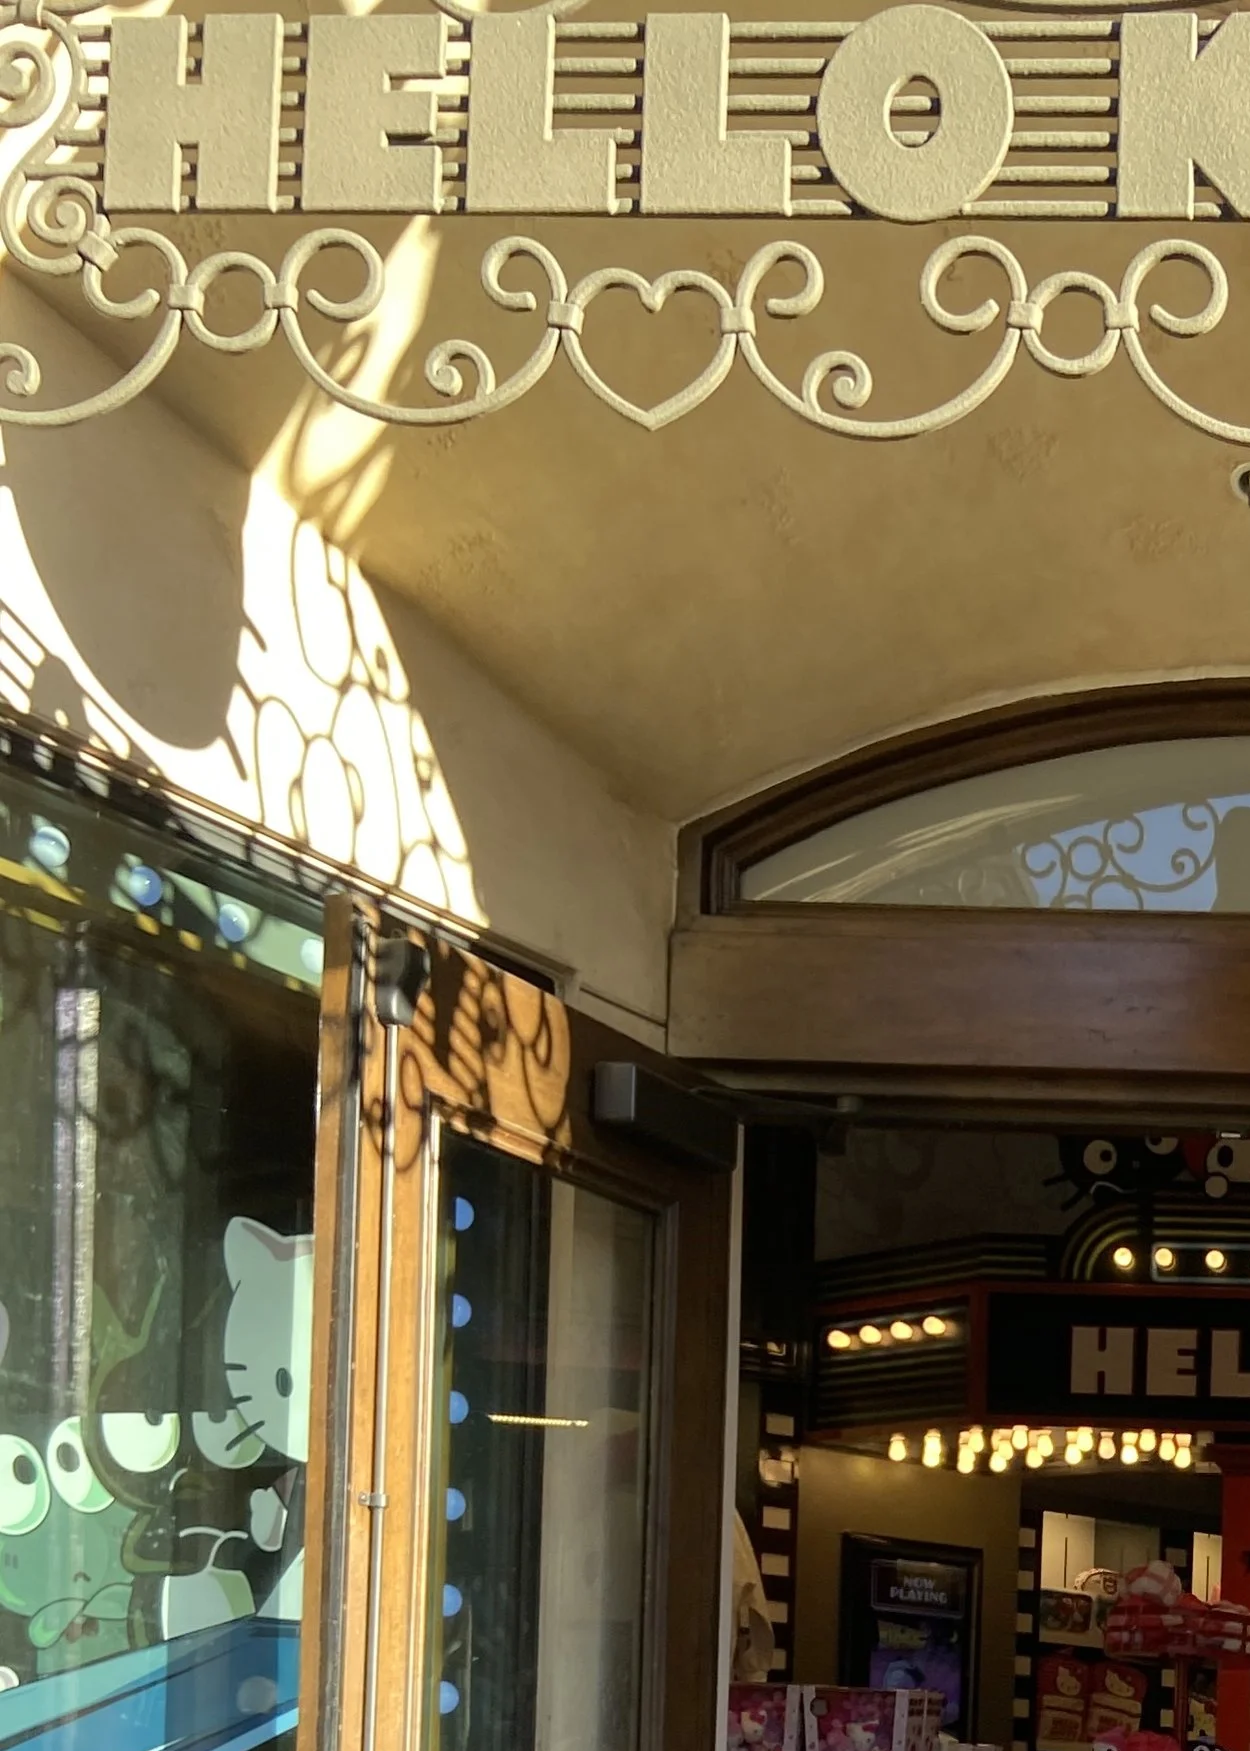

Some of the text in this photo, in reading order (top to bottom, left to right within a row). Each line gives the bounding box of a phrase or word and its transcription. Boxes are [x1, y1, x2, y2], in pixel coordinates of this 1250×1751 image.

[102, 4, 1013, 222] HELLO
[903, 1575, 936, 1590] NOW
[890, 1586, 948, 1604] PLAYING
